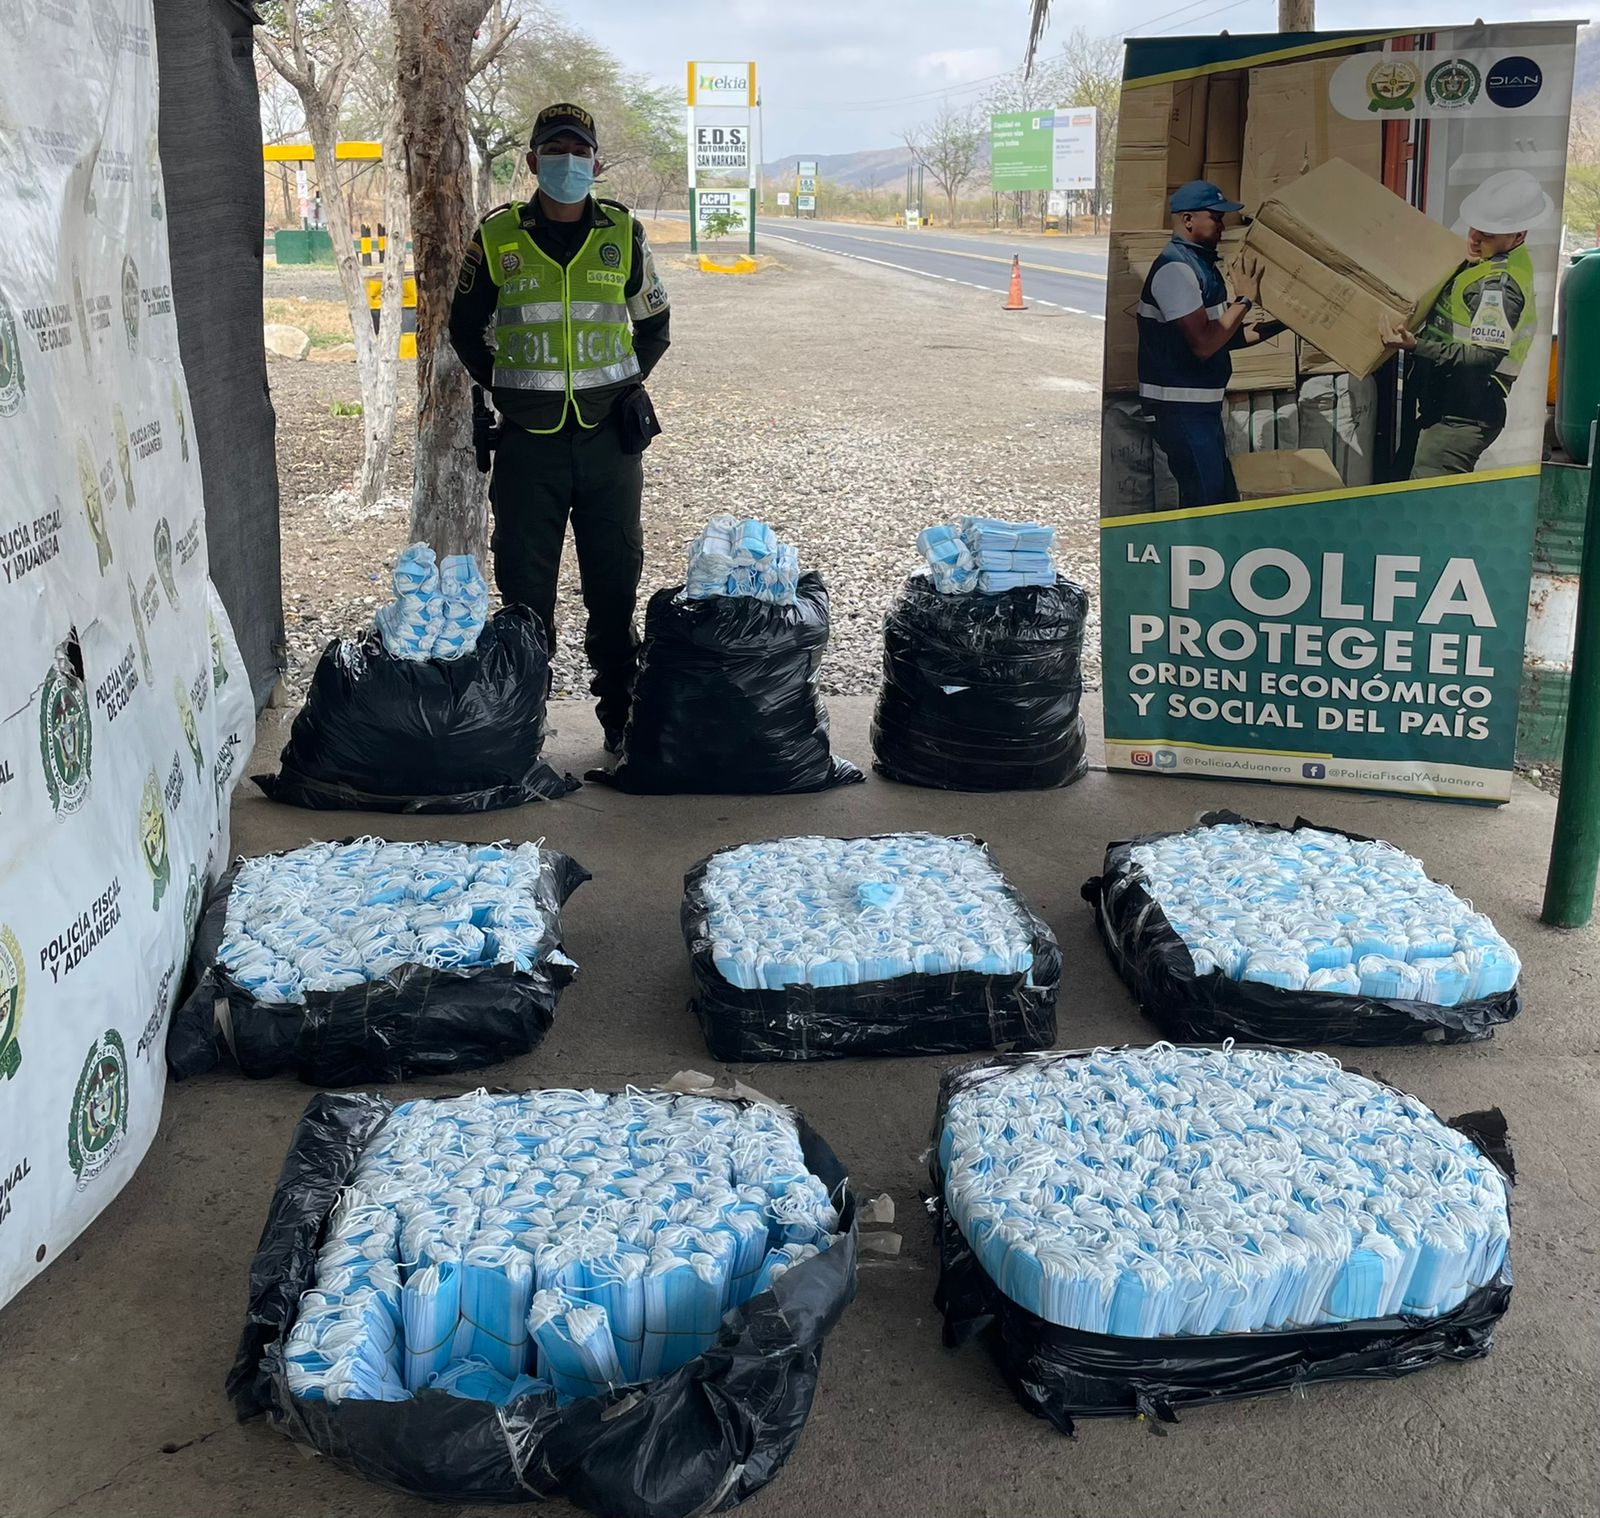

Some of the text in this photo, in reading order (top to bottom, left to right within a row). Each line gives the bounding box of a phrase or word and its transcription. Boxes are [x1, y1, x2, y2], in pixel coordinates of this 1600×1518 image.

[1489, 75, 1539, 86] DIAN
[541, 107, 592, 128] POLICIA
[697, 128, 746, 145] E.D.S.
[697, 145, 746, 153] AUTOMOTRIZ
[697, 155, 746, 167] SAN MARKANDA
[701, 193, 729, 205] ACPM
[0, 509, 62, 559] OLICÍA FISCAL
[1126, 542, 1161, 564] LA
[2, 560, 12, 584] Y
[1169, 545, 1498, 628] POLFA
[1128, 614, 1496, 677] PROTEGE EL
[1128, 662, 1493, 709] ORDEN ECONÓMICO
[1129, 691, 1490, 741] Y SOCIAL DEL PAÍS
[1182, 755, 1485, 789] @PoliciaAduanera @PoliciaFiscalYAduanera
[40, 876, 121, 971] POLICÍA FISCAL
[50, 902, 122, 984] Y ADUANERA
